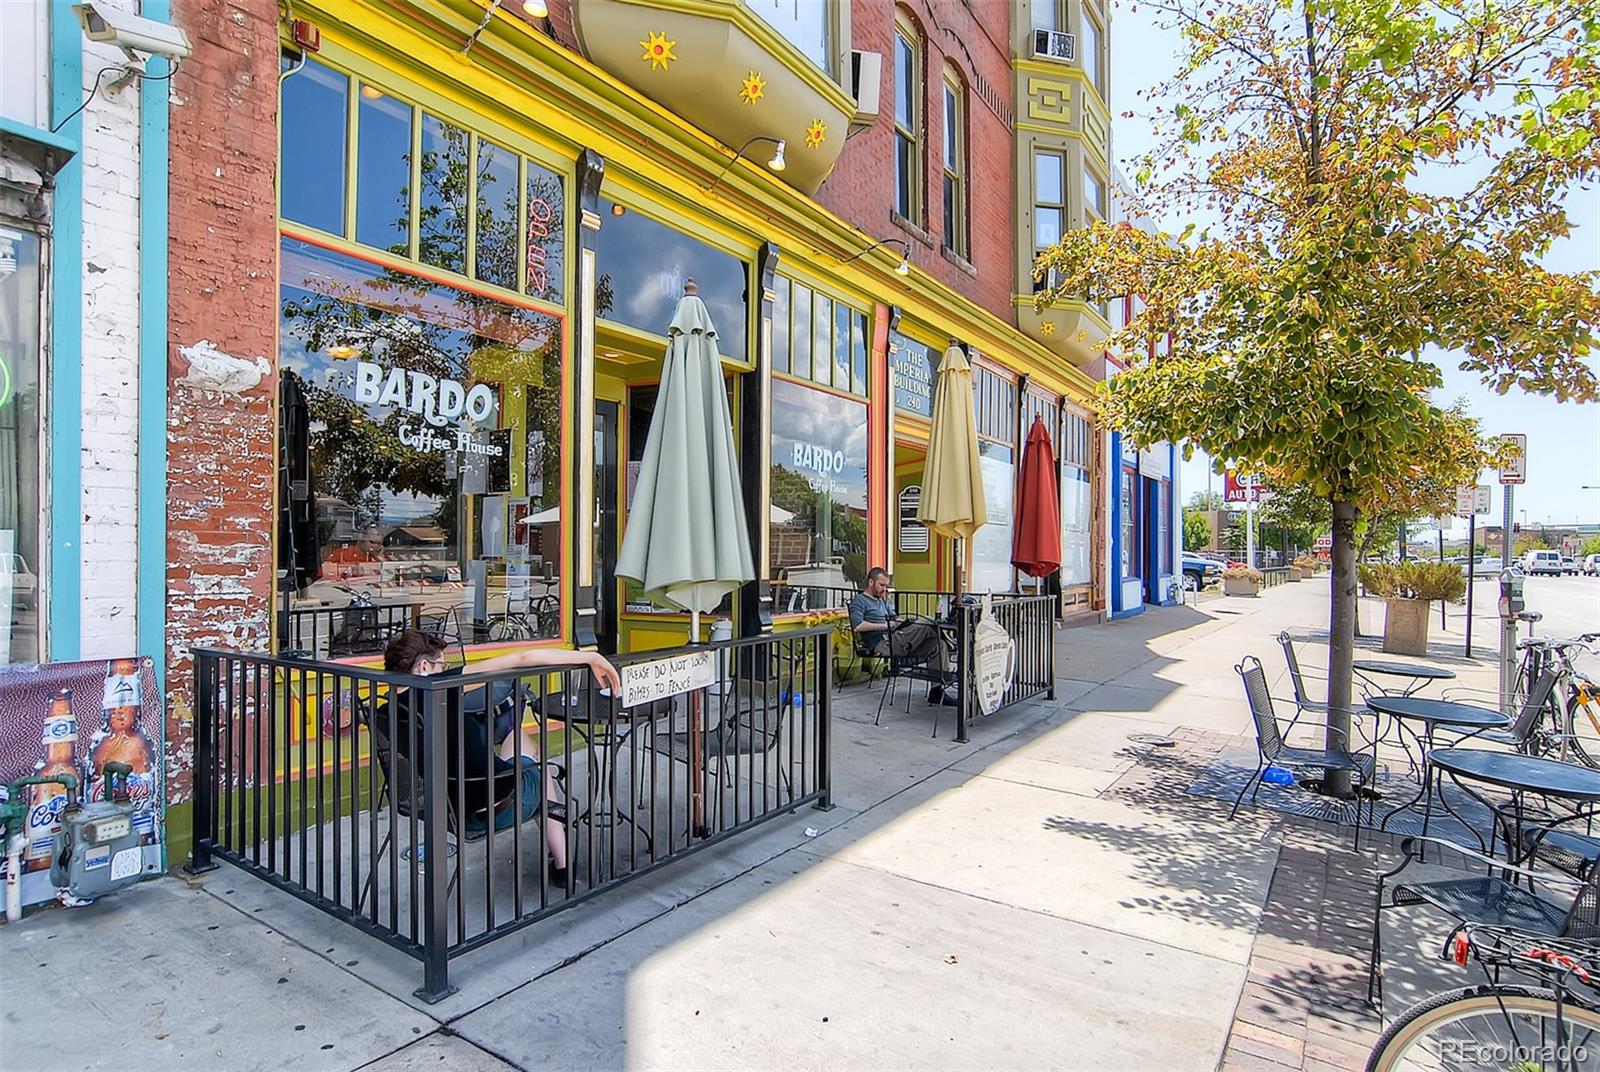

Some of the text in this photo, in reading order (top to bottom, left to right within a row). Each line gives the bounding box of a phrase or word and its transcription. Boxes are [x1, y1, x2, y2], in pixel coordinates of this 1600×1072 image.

[525, 199, 551, 292] OPEN
[906, 349, 924, 367] THE
[356, 362, 493, 426] BARDO
[907, 396, 921, 410] 240
[399, 425, 503, 456] Coffee House
[793, 442, 844, 477] BARDO
[627, 666, 650, 683] PLEASE
[654, 663, 667, 679] DO
[669, 658, 688, 677] NOT
[628, 685, 650, 703] BIKES
[655, 682, 665, 694] TO
[668, 676, 690, 694] FENCE
